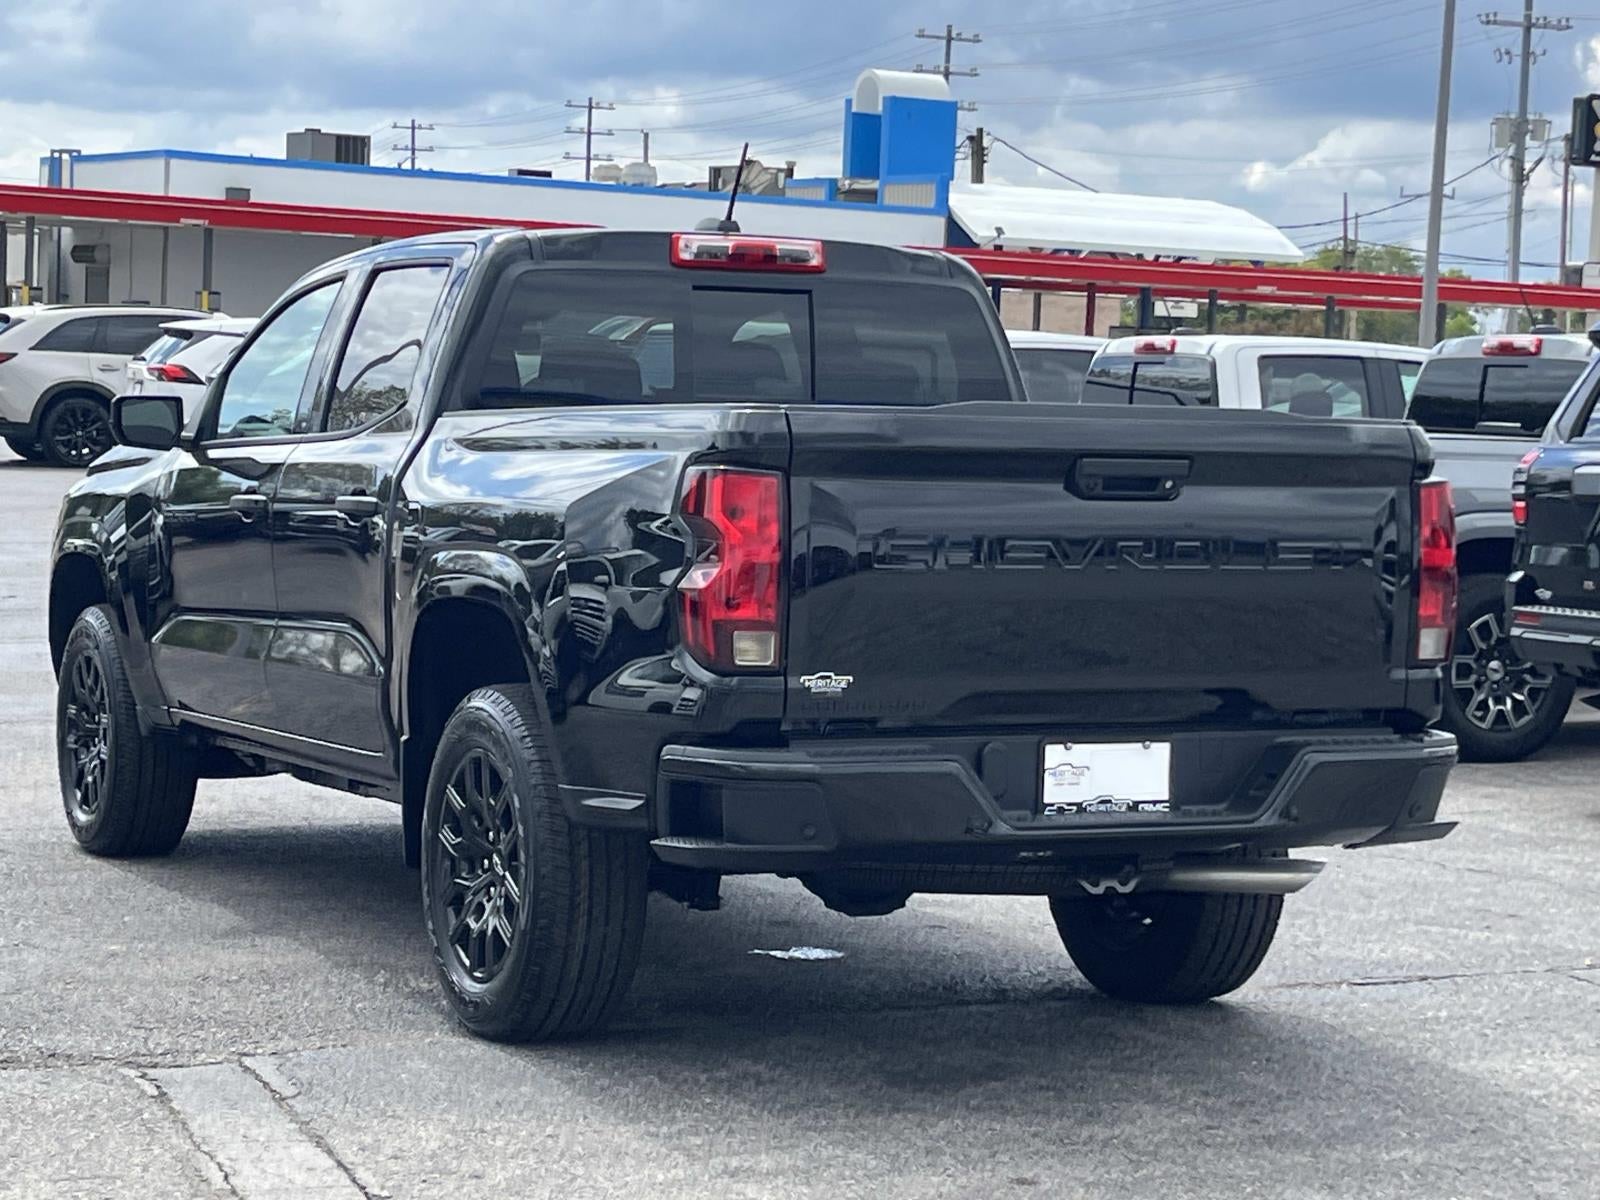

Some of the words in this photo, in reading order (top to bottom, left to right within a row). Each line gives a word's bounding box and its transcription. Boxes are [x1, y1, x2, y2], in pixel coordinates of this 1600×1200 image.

[804, 679, 848, 688] HERITAGE
[1086, 803, 1128, 813] HERITAGE
[1138, 803, 1170, 812] GMC
